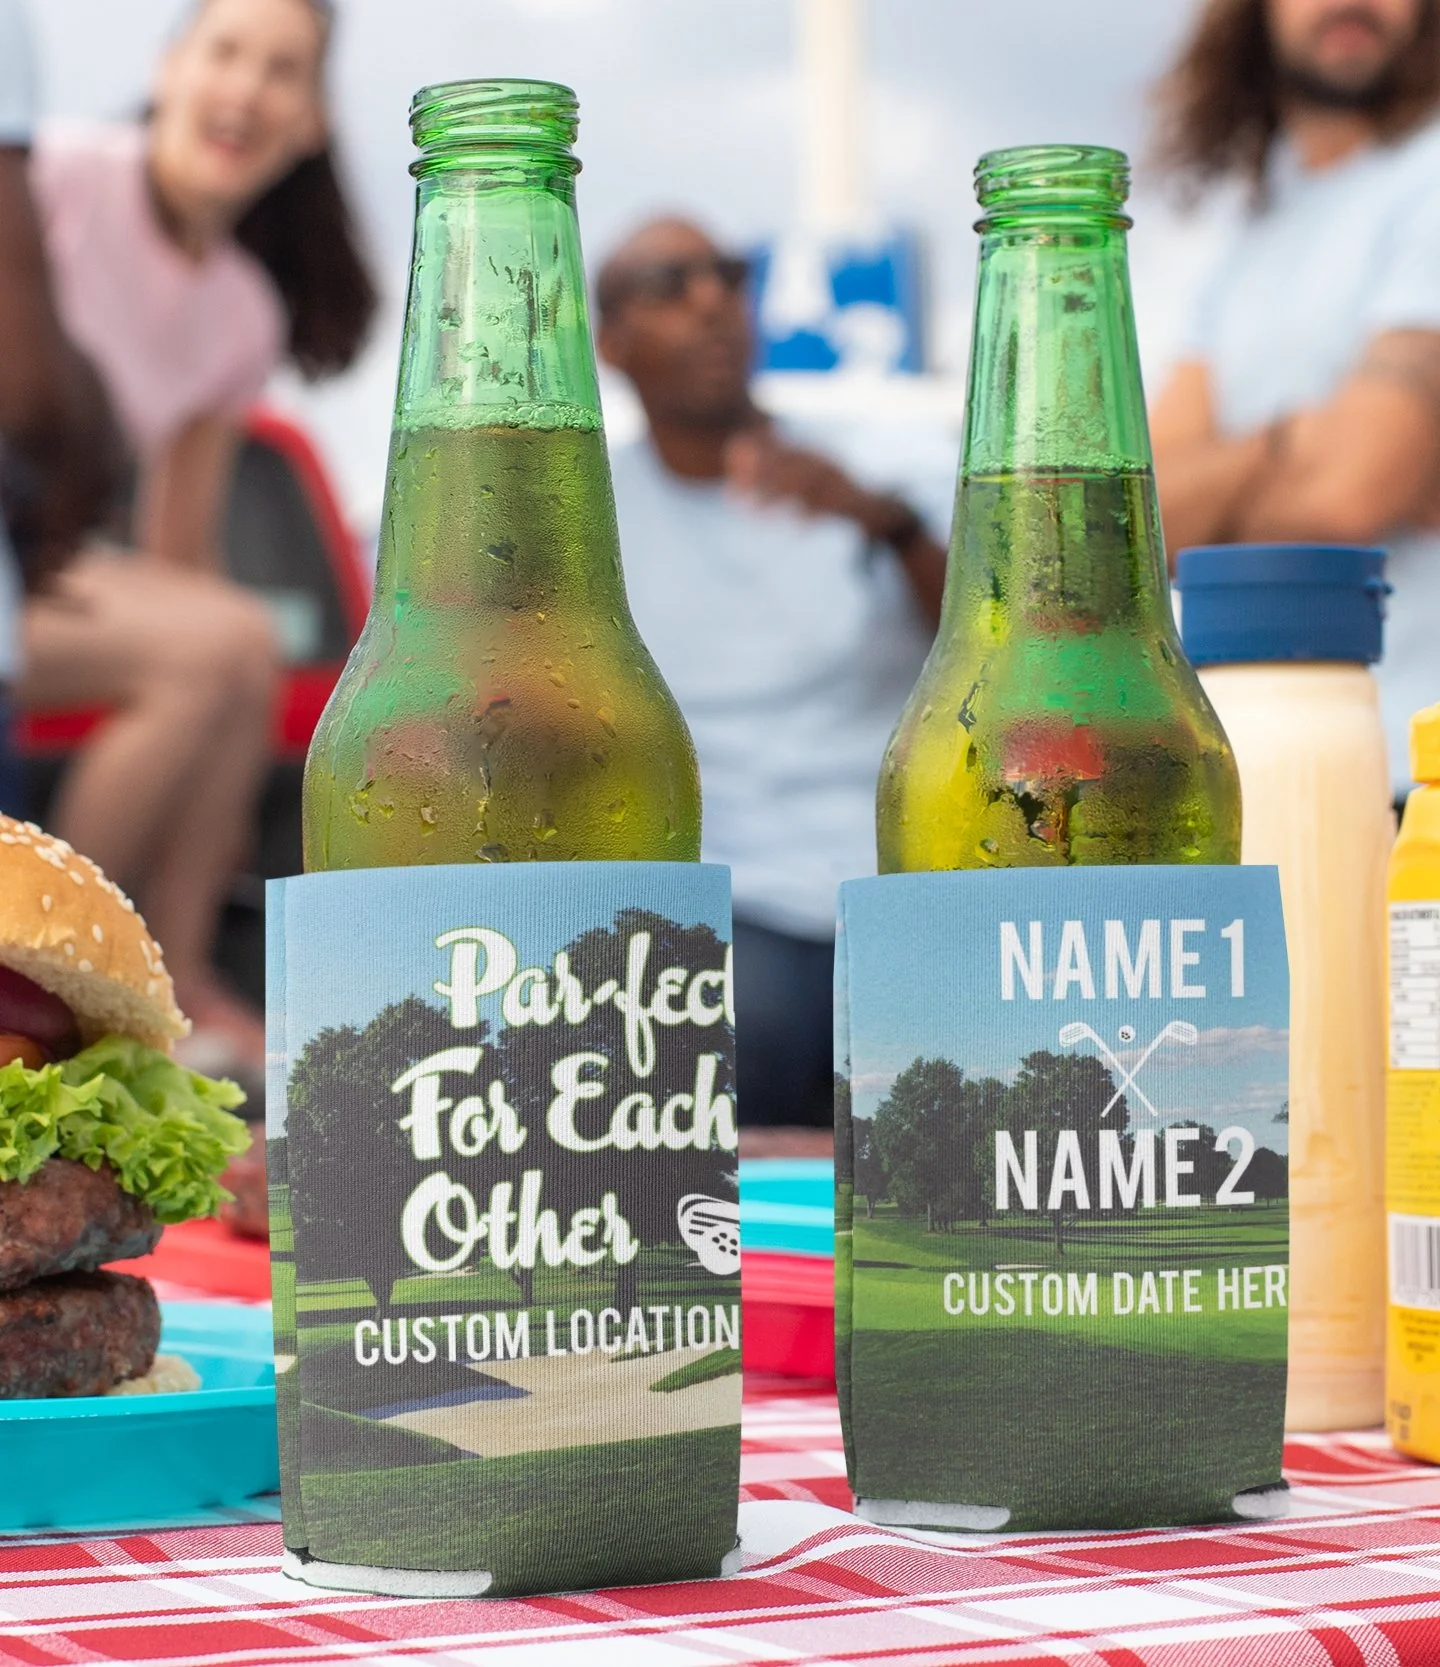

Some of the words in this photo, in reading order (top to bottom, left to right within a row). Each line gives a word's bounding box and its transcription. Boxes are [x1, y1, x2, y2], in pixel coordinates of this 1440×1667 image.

[392, 1046, 527, 1160] For
[546, 1052, 738, 1151] Each
[400, 1170, 638, 1271] Other
[943, 1273, 1098, 1316] CUSTOM
[1112, 1270, 1202, 1314] DATE
[354, 1310, 529, 1366] CUSTOM
[547, 1304, 739, 1356] LOCATION
